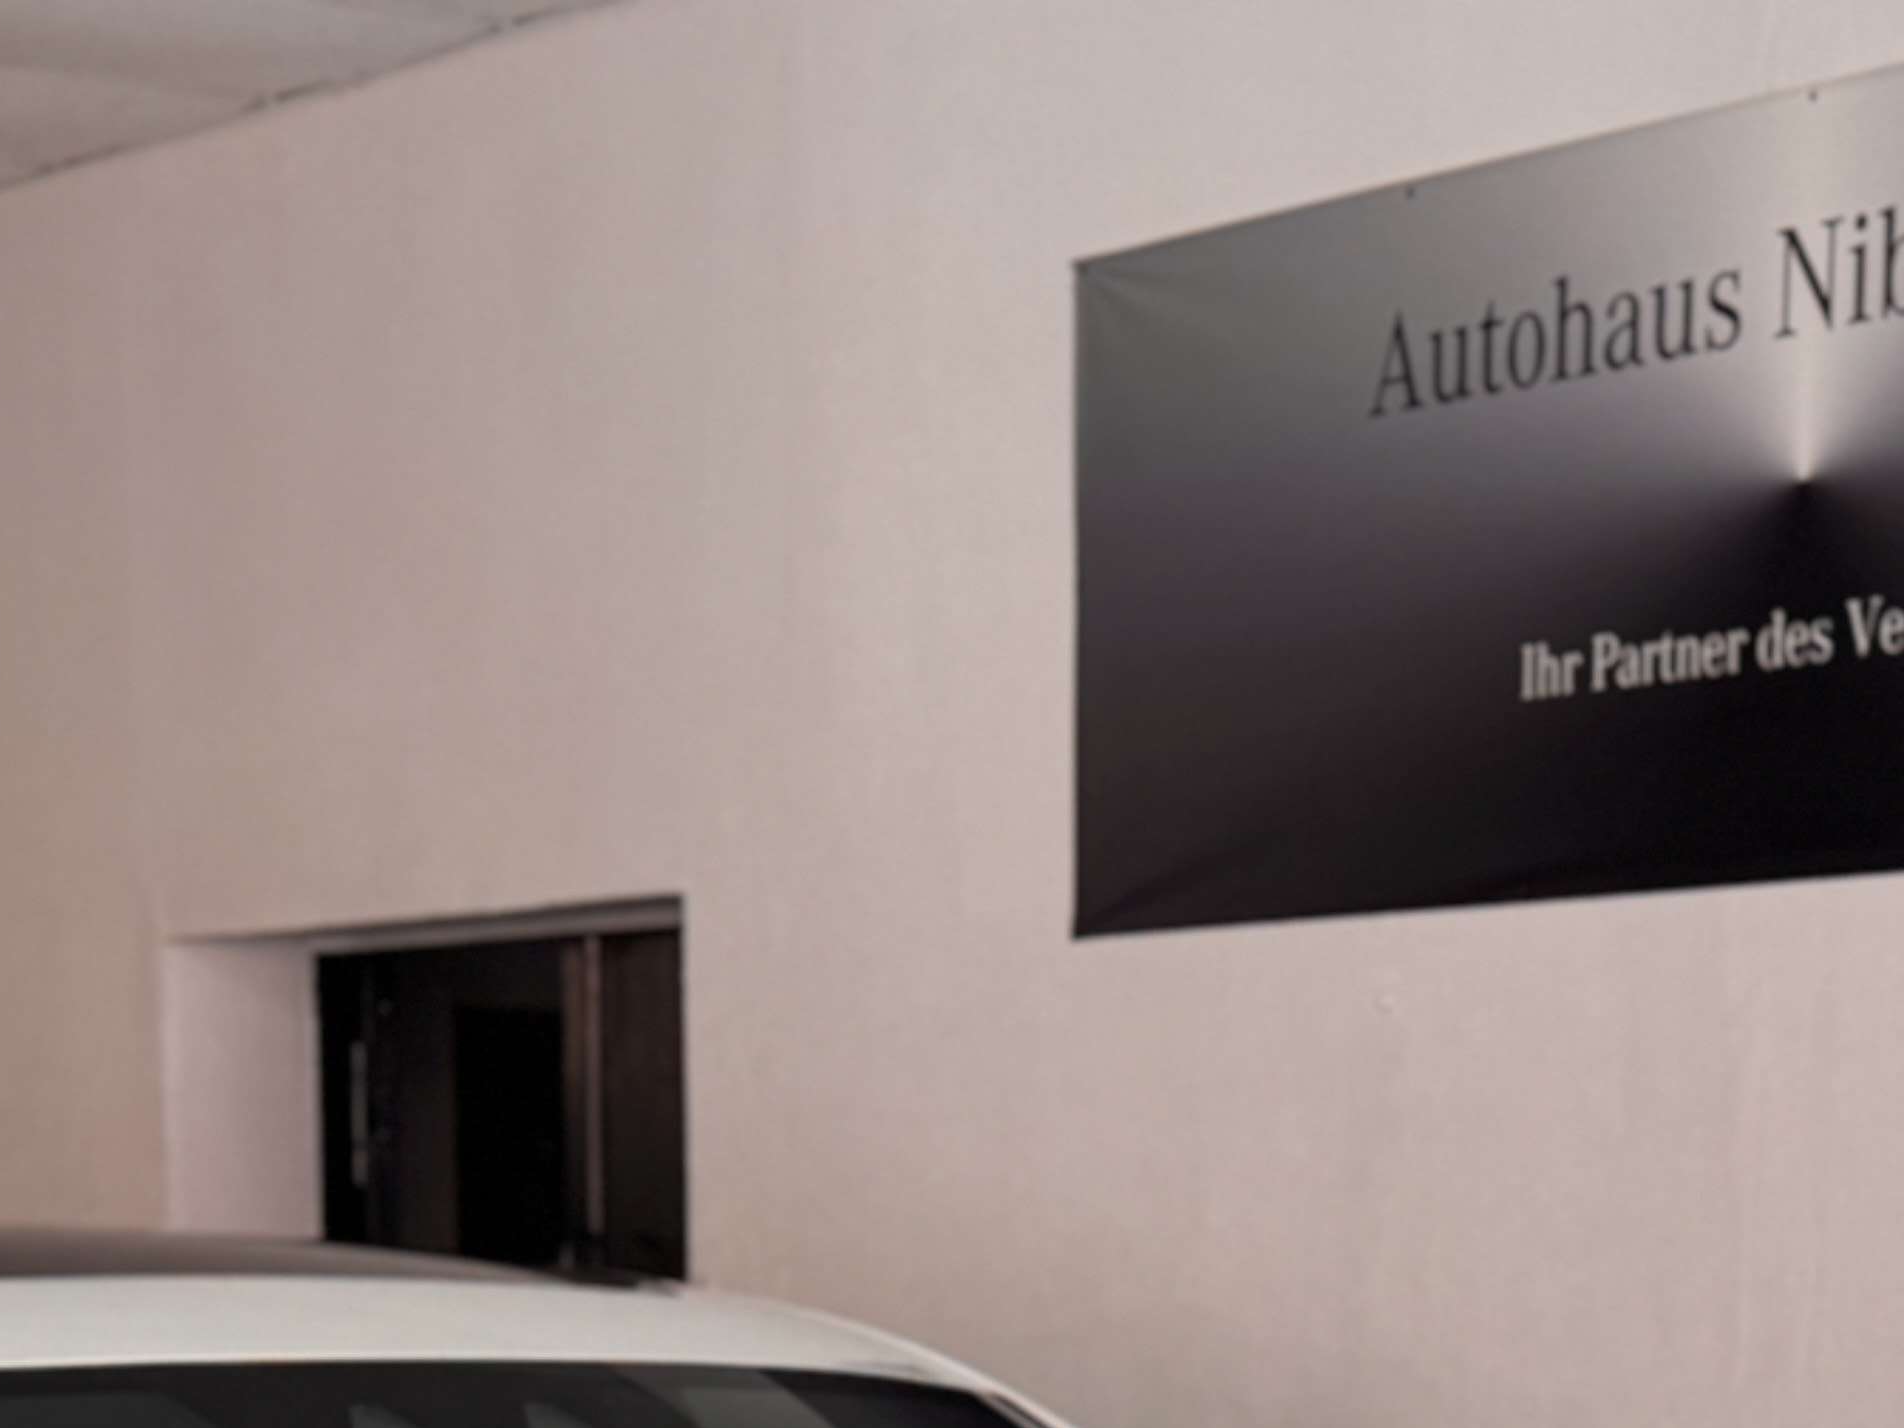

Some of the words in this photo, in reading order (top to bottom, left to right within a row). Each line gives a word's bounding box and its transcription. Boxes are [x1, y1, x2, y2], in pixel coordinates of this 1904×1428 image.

[1369, 269, 1744, 418] Autohaus
[1520, 641, 1584, 700] Ihr
[1590, 629, 1750, 692] Partner
[1755, 608, 1834, 673] des
